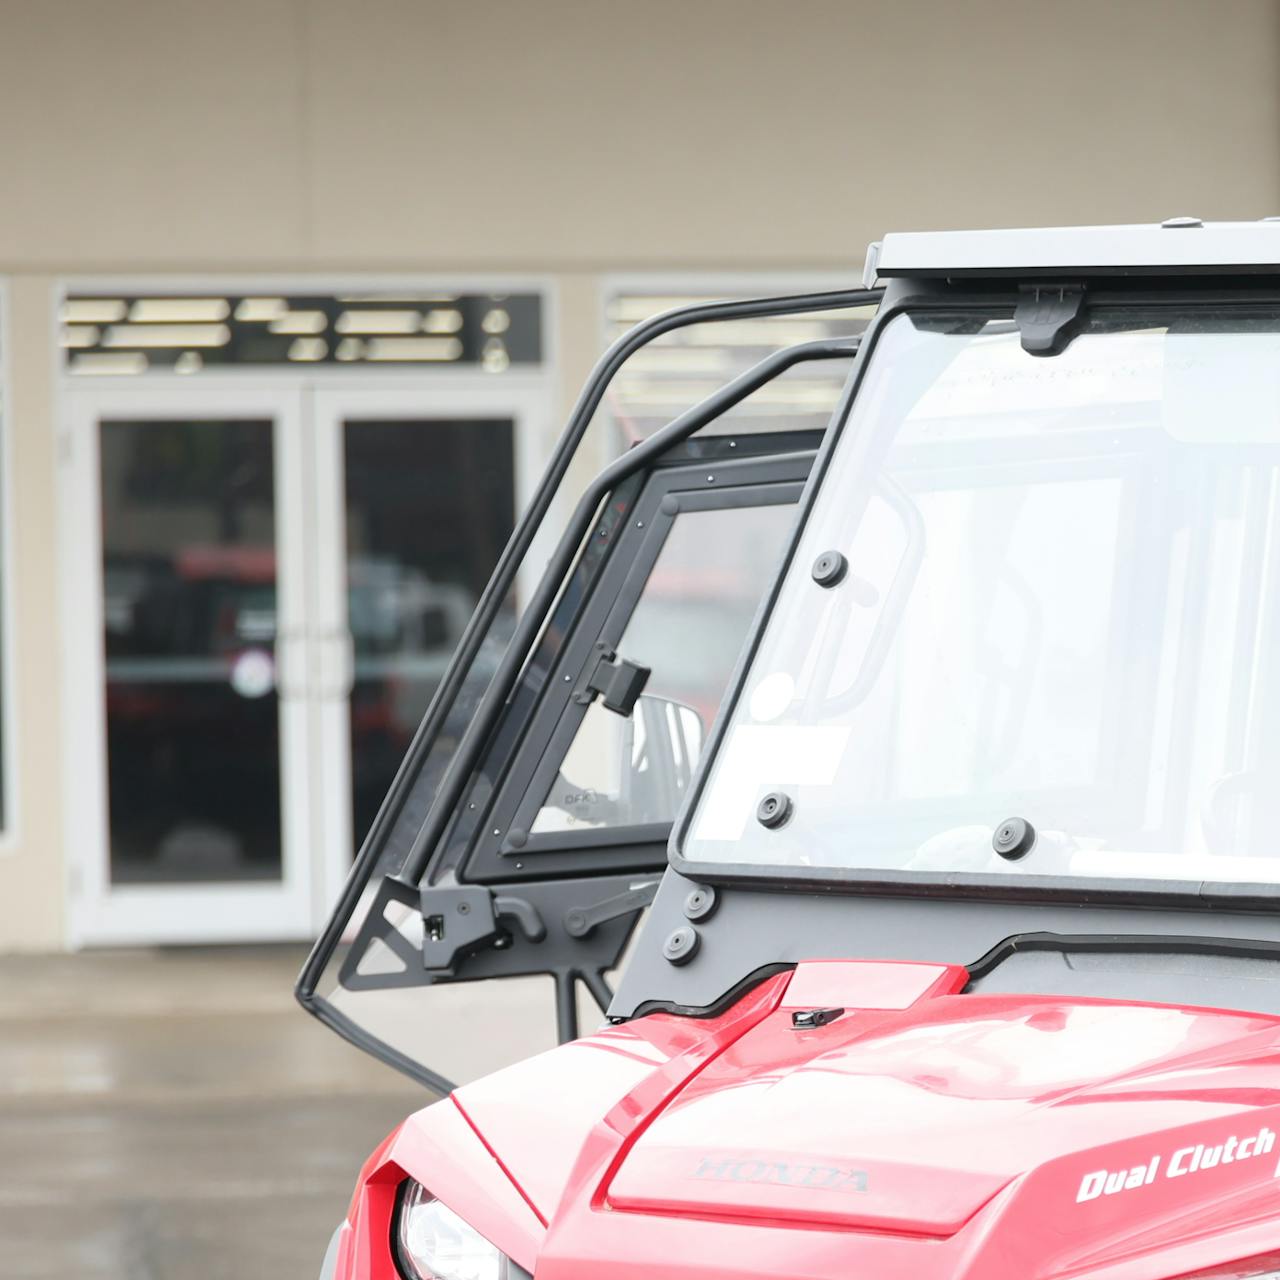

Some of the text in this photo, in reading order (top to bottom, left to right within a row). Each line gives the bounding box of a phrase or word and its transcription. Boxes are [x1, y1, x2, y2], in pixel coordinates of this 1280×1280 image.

[690, 1157, 869, 1193] HONDA
[1075, 1155, 1161, 1204] Dual
[1166, 1127, 1276, 1178] Clutch
